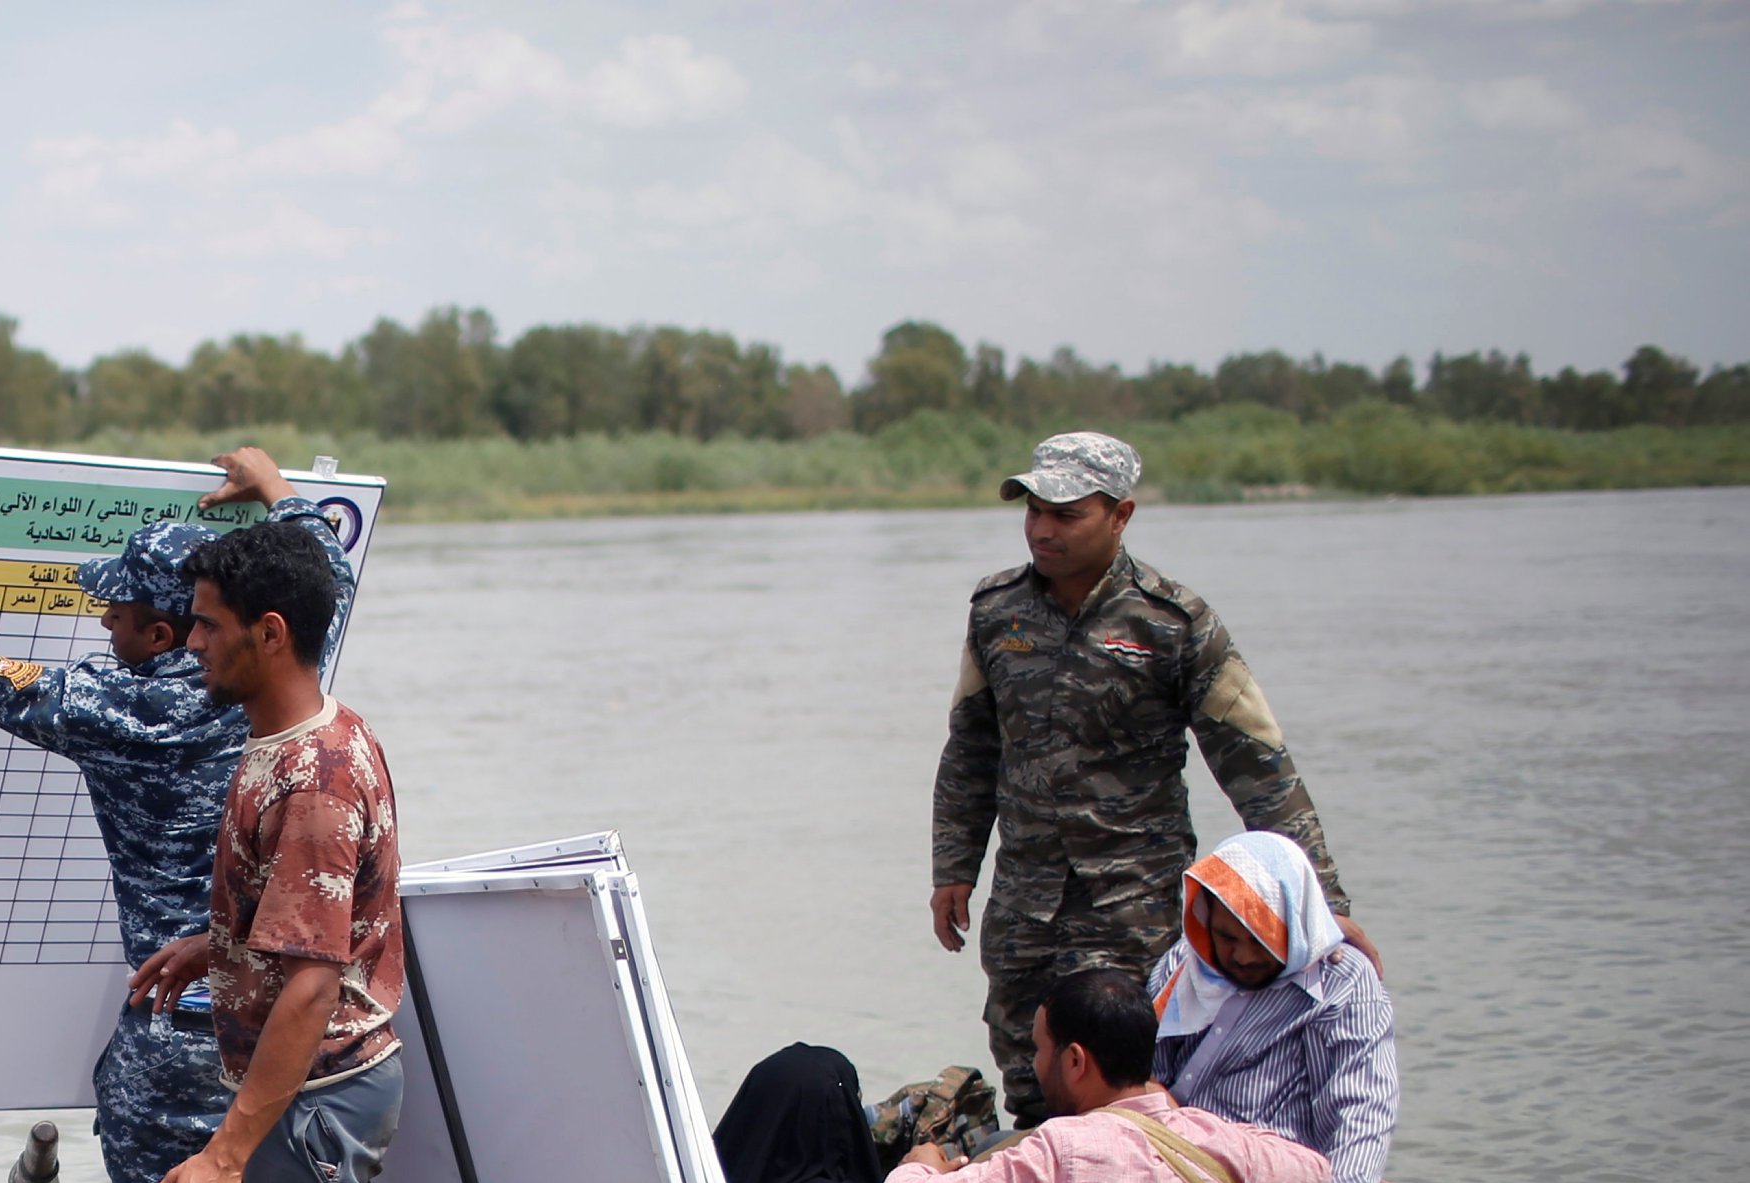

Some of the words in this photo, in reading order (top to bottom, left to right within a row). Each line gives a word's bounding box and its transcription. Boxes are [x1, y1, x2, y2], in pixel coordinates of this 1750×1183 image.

[0, 491, 37, 516] الآلي
[41, 496, 82, 516] اللواء
[96, 499, 138, 523] الثاني
[141, 502, 181, 524] الفوج
[26, 521, 76, 544] اتحادية
[80, 525, 124, 548] شرطة
[28, 564, 60, 587] الفنية
[10, 594, 37, 606] مدمر
[47, 593, 75, 610] عاطل
